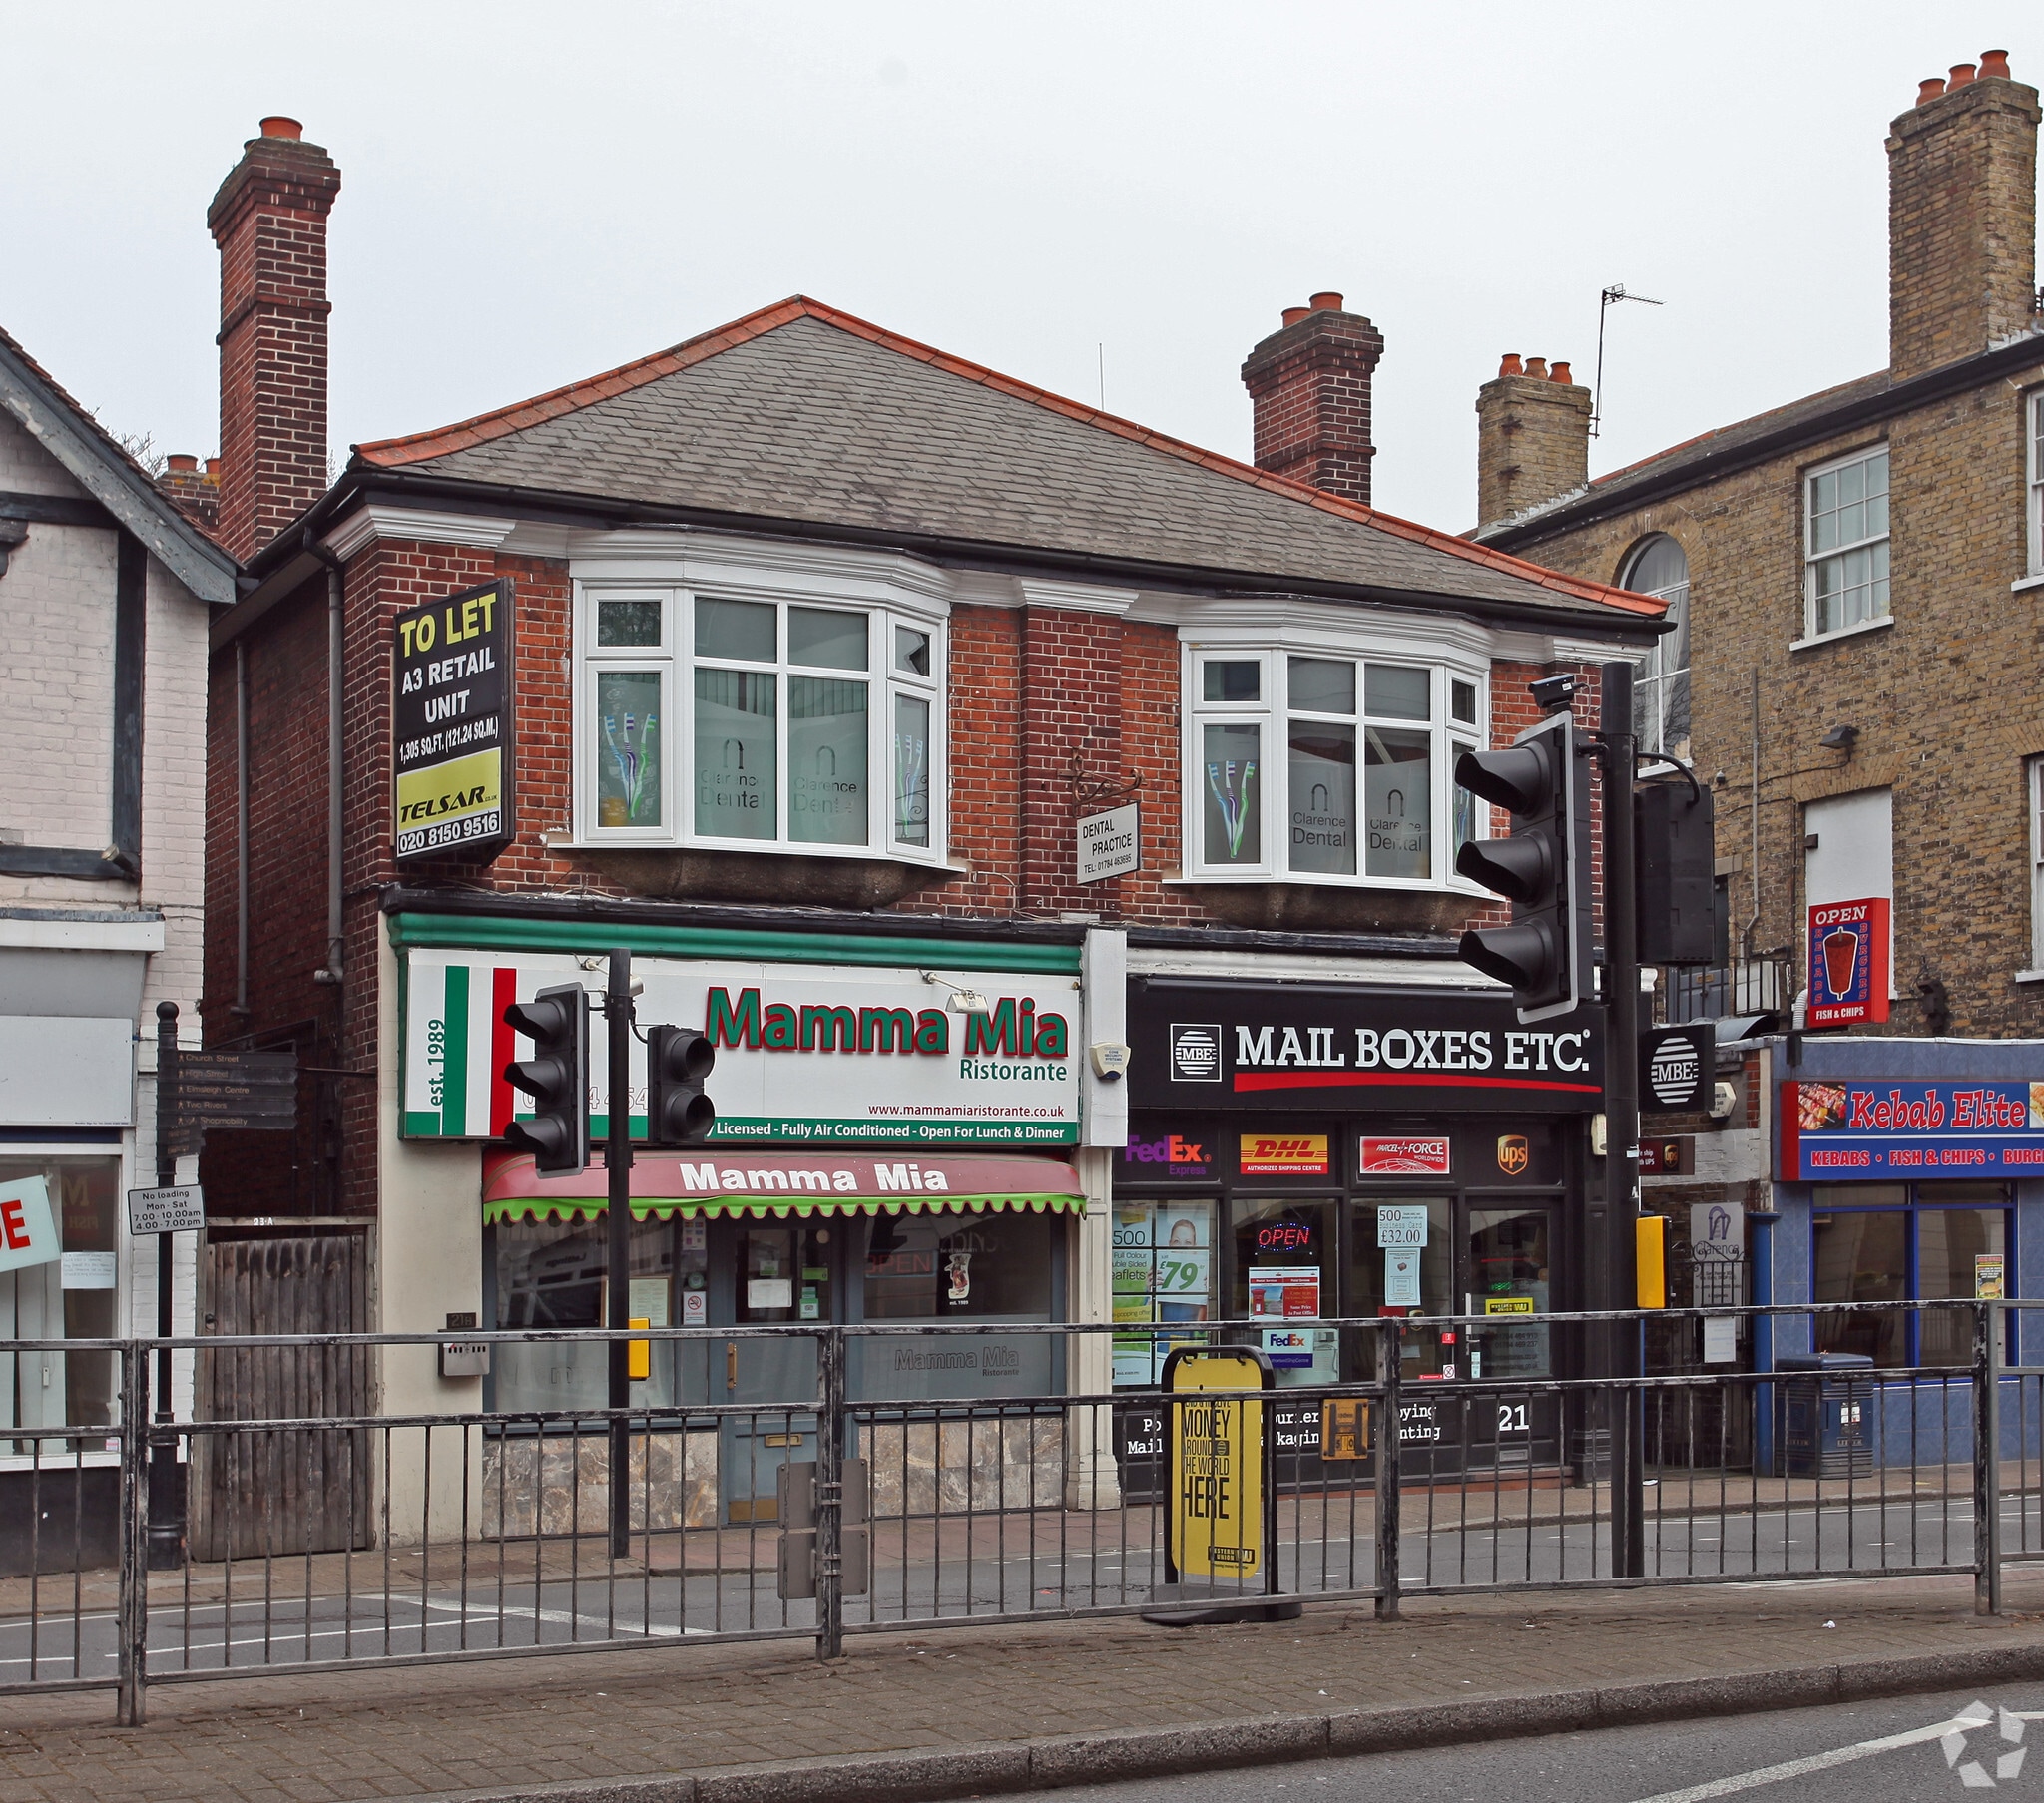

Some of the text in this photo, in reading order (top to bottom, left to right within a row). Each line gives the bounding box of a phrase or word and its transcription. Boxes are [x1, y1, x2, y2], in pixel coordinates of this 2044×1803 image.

[400, 593, 496, 658] TO LET
[402, 646, 495, 694] A3 RETAIL
[424, 689, 470, 723] UNIT
[399, 738, 419, 764] 1,305
[445, 724, 472, 753] (121.24
[400, 785, 485, 823] TELSAR
[1083, 819, 1115, 839] DENTAL
[1293, 812, 1346, 827] Clarence
[400, 813, 498, 852] 020 8150 9516
[1293, 827, 1346, 847] Dental
[1092, 833, 1132, 856] PRACTICE
[1815, 905, 1867, 925] OPEN
[706, 986, 1069, 1058] Mamma Mia
[1815, 1006, 1864, 1020] FISH & CHIPS
[1182, 1048, 1213, 1061] MBE
[1235, 1026, 1345, 1067] MAIL
[1355, 1029, 1493, 1070] BOXES
[216, 1054, 239, 1063] Street
[427, 1019, 445, 1106] est. 1989
[960, 1059, 1068, 1082] Ristorante
[1658, 1062, 1694, 1082] MBE
[204, 1101, 228, 1110] Rivers
[868, 1104, 1065, 1118] www.mammamiaristorante.co.uk
[1849, 1088, 2026, 1130] Kebab Elite
[717, 1122, 771, 1136] Licensed
[782, 1124, 811, 1140] Fully
[814, 1124, 832, 1136] Air
[835, 1124, 910, 1138] Conditioned
[920, 1127, 951, 1140] Open
[955, 1127, 974, 1138] For
[977, 1126, 1011, 1139] Lunch
[1013, 1127, 1023, 1139] &
[1026, 1127, 1065, 1139] Dinner
[1125, 1135, 1203, 1163] FedEx
[1254, 1140, 1315, 1157] DHL
[1408, 1142, 1444, 1155] FORCE
[1500, 1146, 1526, 1169] ups
[1644, 1149, 1654, 1158] ship
[1811, 1148, 2044, 1167] KEBABS FISH & CHIPS BURG
[680, 1163, 949, 1191] Mamma Mia
[1169, 1164, 1207, 1176] Express
[158, 1190, 190, 1199] loading
[0, 1199, 31, 1250] E
[1379, 1209, 1402, 1221] 500
[136, 1221, 158, 1230] 4.00
[1113, 1230, 1146, 1245] 500
[1259, 1229, 1309, 1246] OPEN
[1381, 1229, 1421, 1243] £32.00
[1270, 1333, 1305, 1346] FedEx
[895, 1346, 1019, 1371] Mamma Mia
[982, 1368, 1019, 1377] Ristorante
[1498, 1404, 1530, 1432] 21
[1186, 1440, 1213, 1456] ROUND
